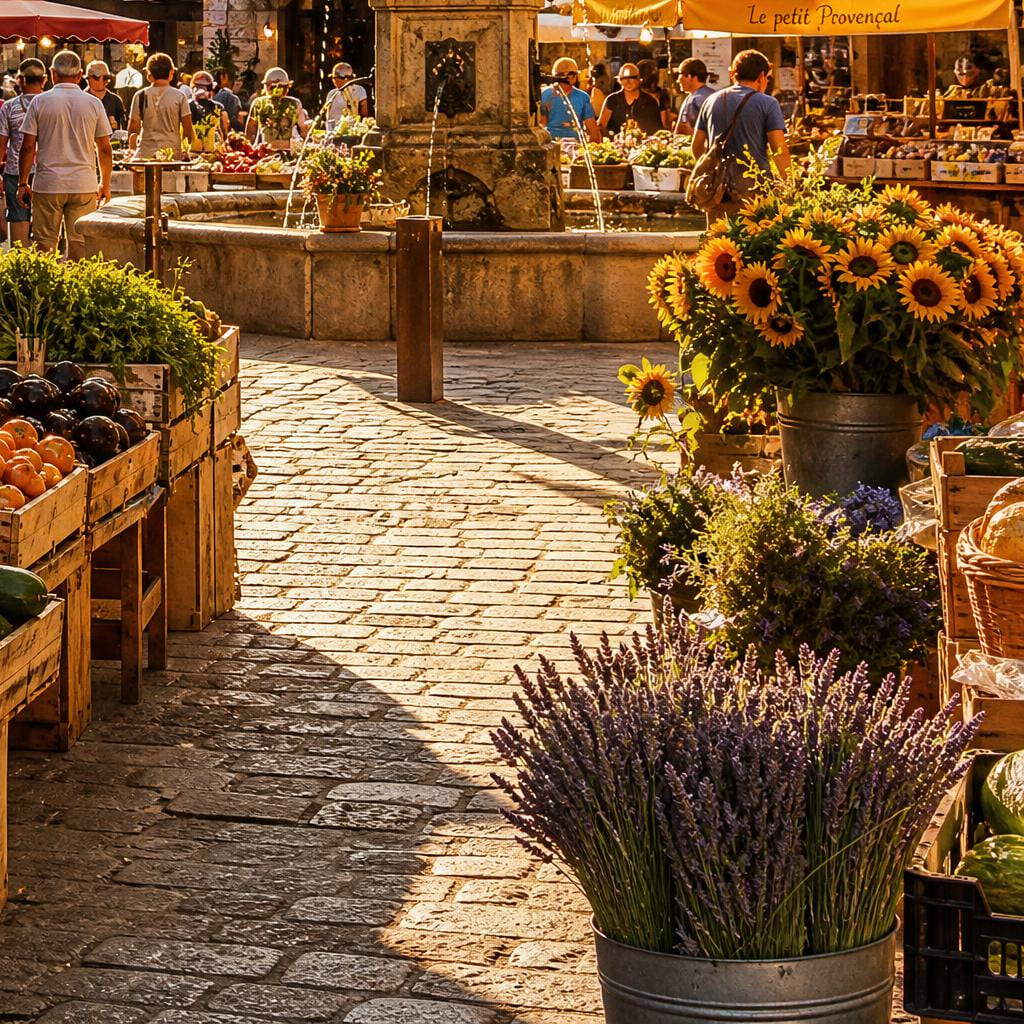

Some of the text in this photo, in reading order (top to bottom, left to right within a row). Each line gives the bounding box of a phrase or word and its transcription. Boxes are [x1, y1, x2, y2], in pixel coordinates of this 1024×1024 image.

[747, 3, 901, 32] Le petit Provençal
